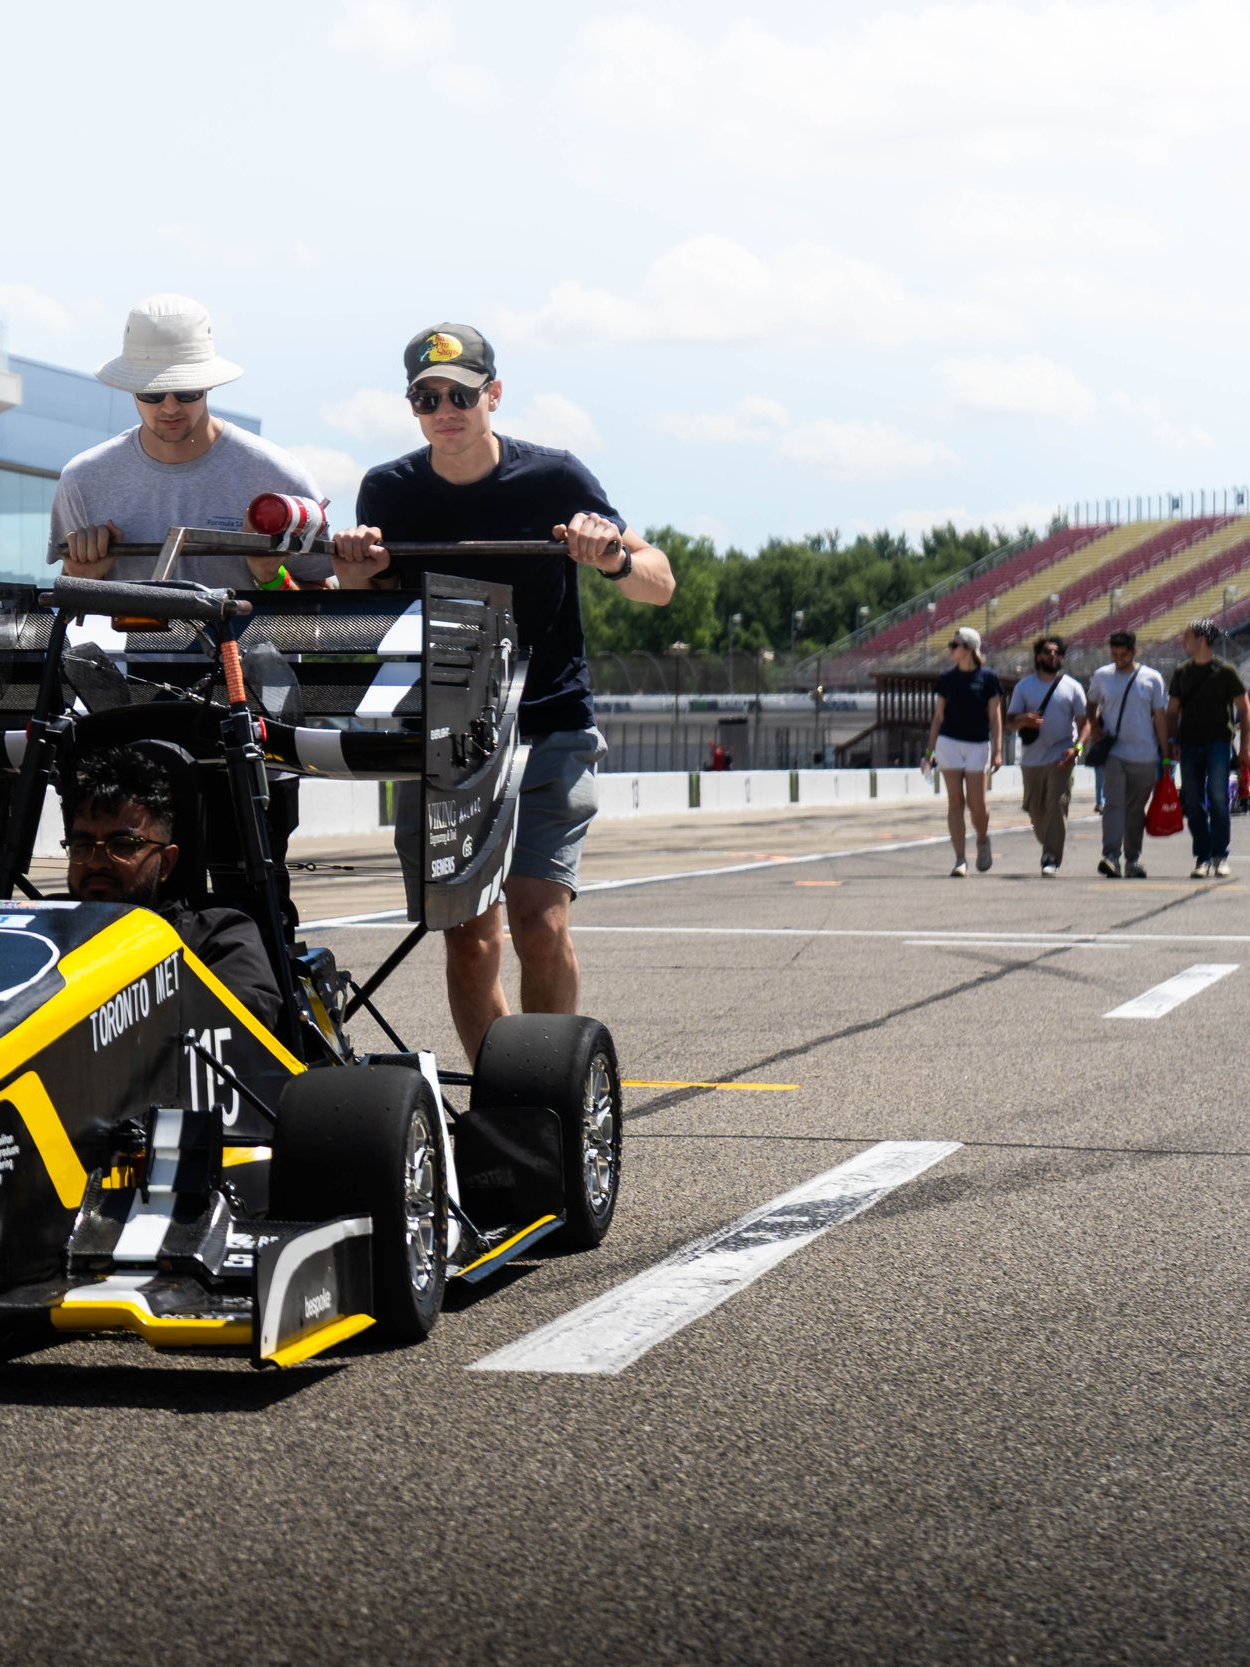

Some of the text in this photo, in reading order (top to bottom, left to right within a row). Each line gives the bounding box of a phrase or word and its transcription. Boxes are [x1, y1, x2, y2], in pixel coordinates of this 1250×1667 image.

[89, 951, 179, 1052] TORONTO MET
[304, 1287, 332, 1319] bespoke
